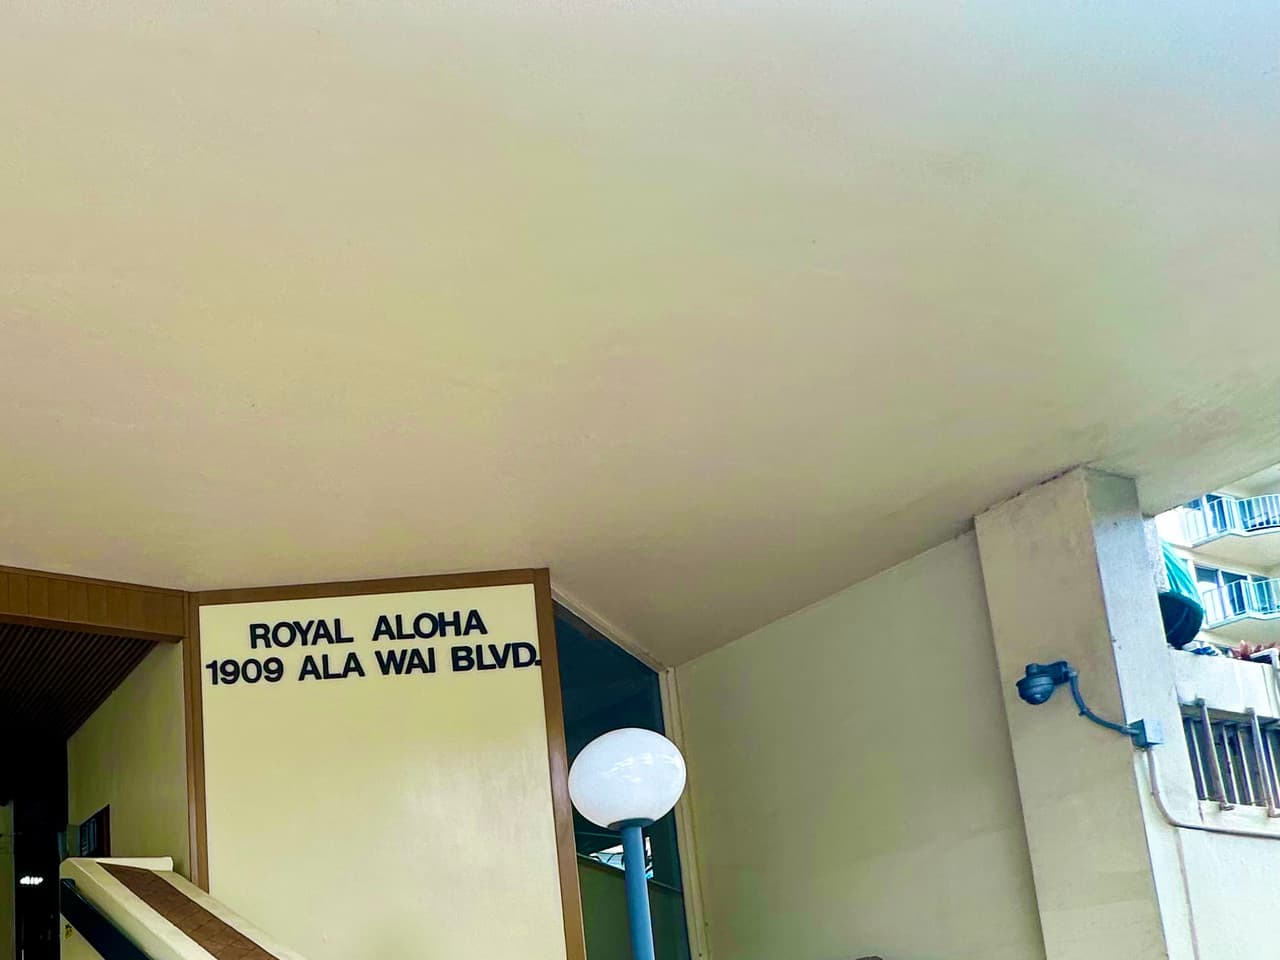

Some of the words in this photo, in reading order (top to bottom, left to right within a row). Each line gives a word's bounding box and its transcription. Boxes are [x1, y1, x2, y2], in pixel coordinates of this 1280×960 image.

[250, 618, 354, 649] ROYAL
[372, 609, 488, 641] ALOHA
[206, 657, 284, 685] 1909
[298, 652, 365, 681] ALA
[375, 647, 436, 675] WAI
[451, 641, 541, 672] BLVD.
